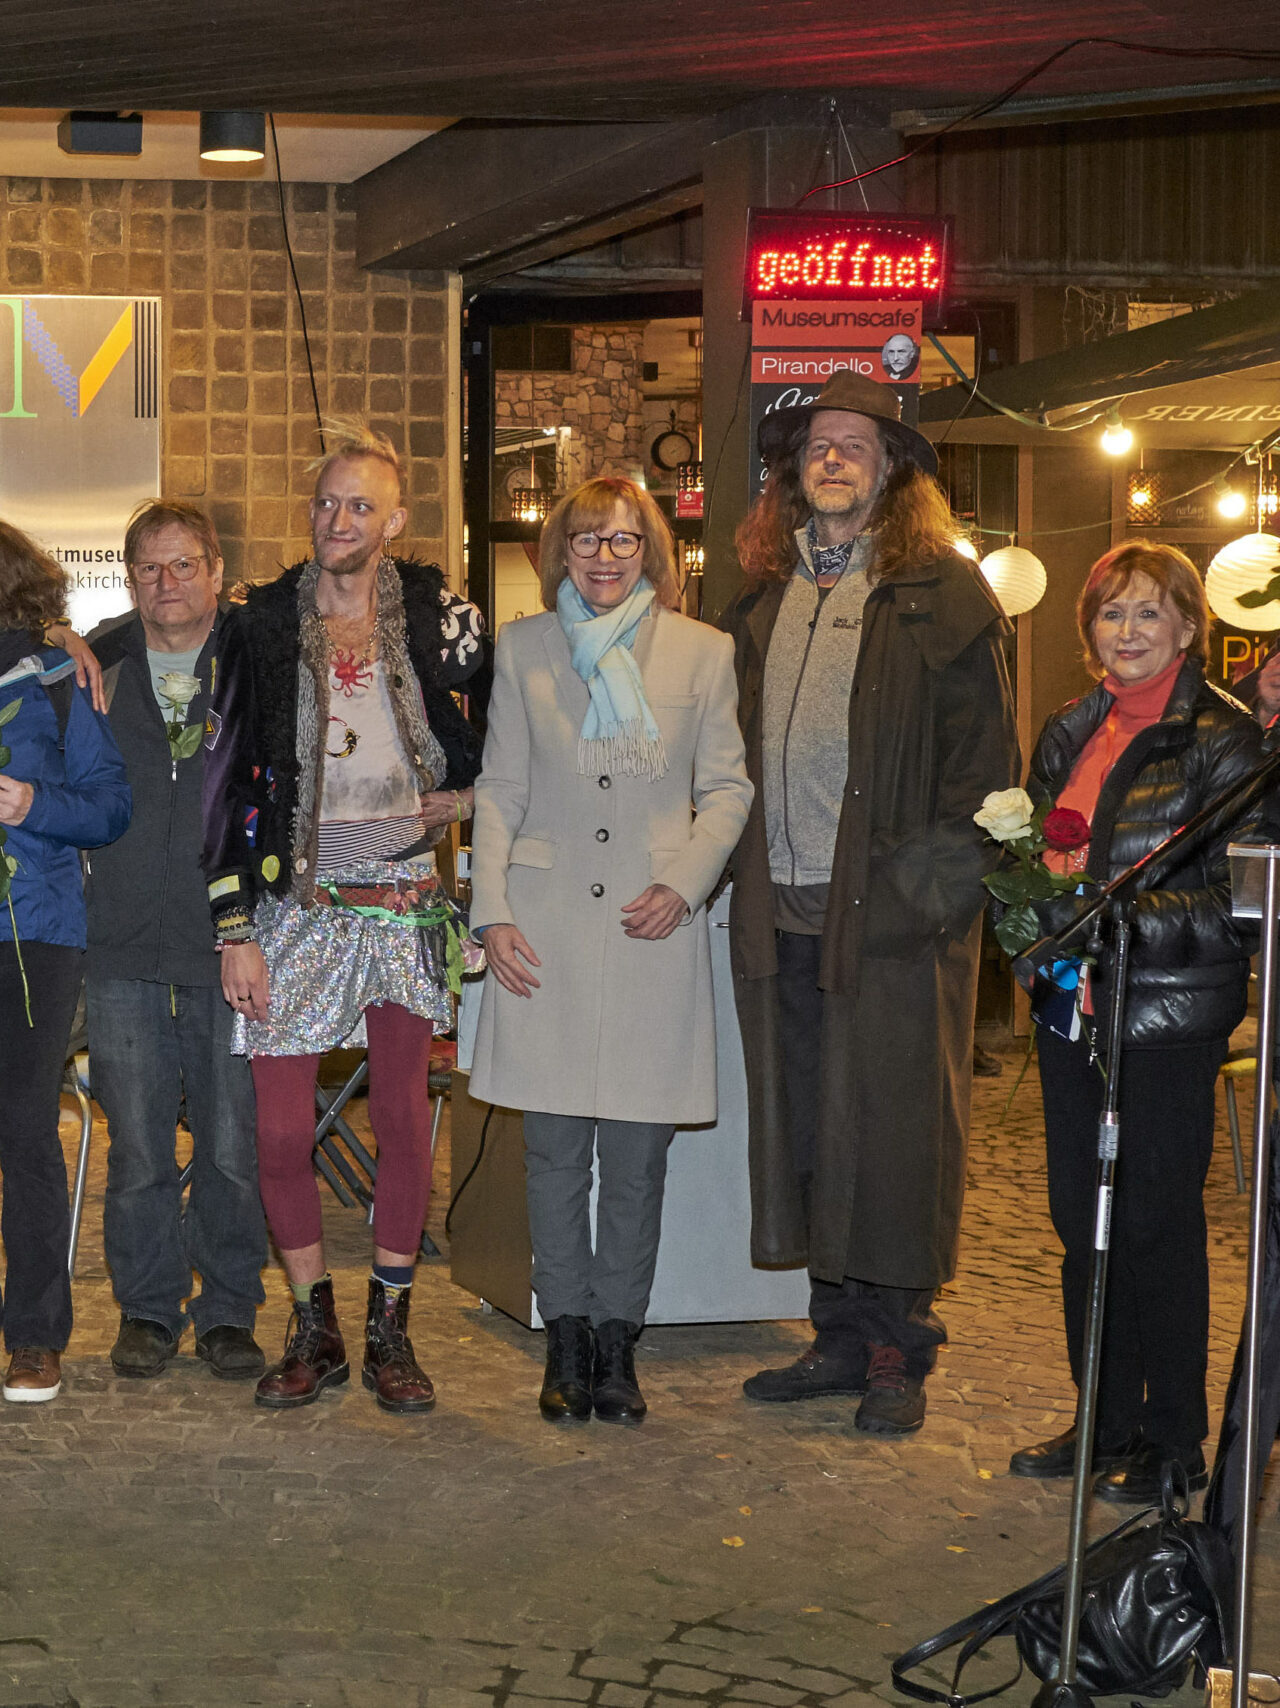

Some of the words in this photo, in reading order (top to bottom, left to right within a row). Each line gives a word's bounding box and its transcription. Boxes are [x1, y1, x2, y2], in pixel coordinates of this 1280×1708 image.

[756, 241, 940, 292] geöffnet
[761, 357, 874, 376] Pirandello
[76, 571, 132, 589] kirche
[1222, 635, 1269, 680] Pi
